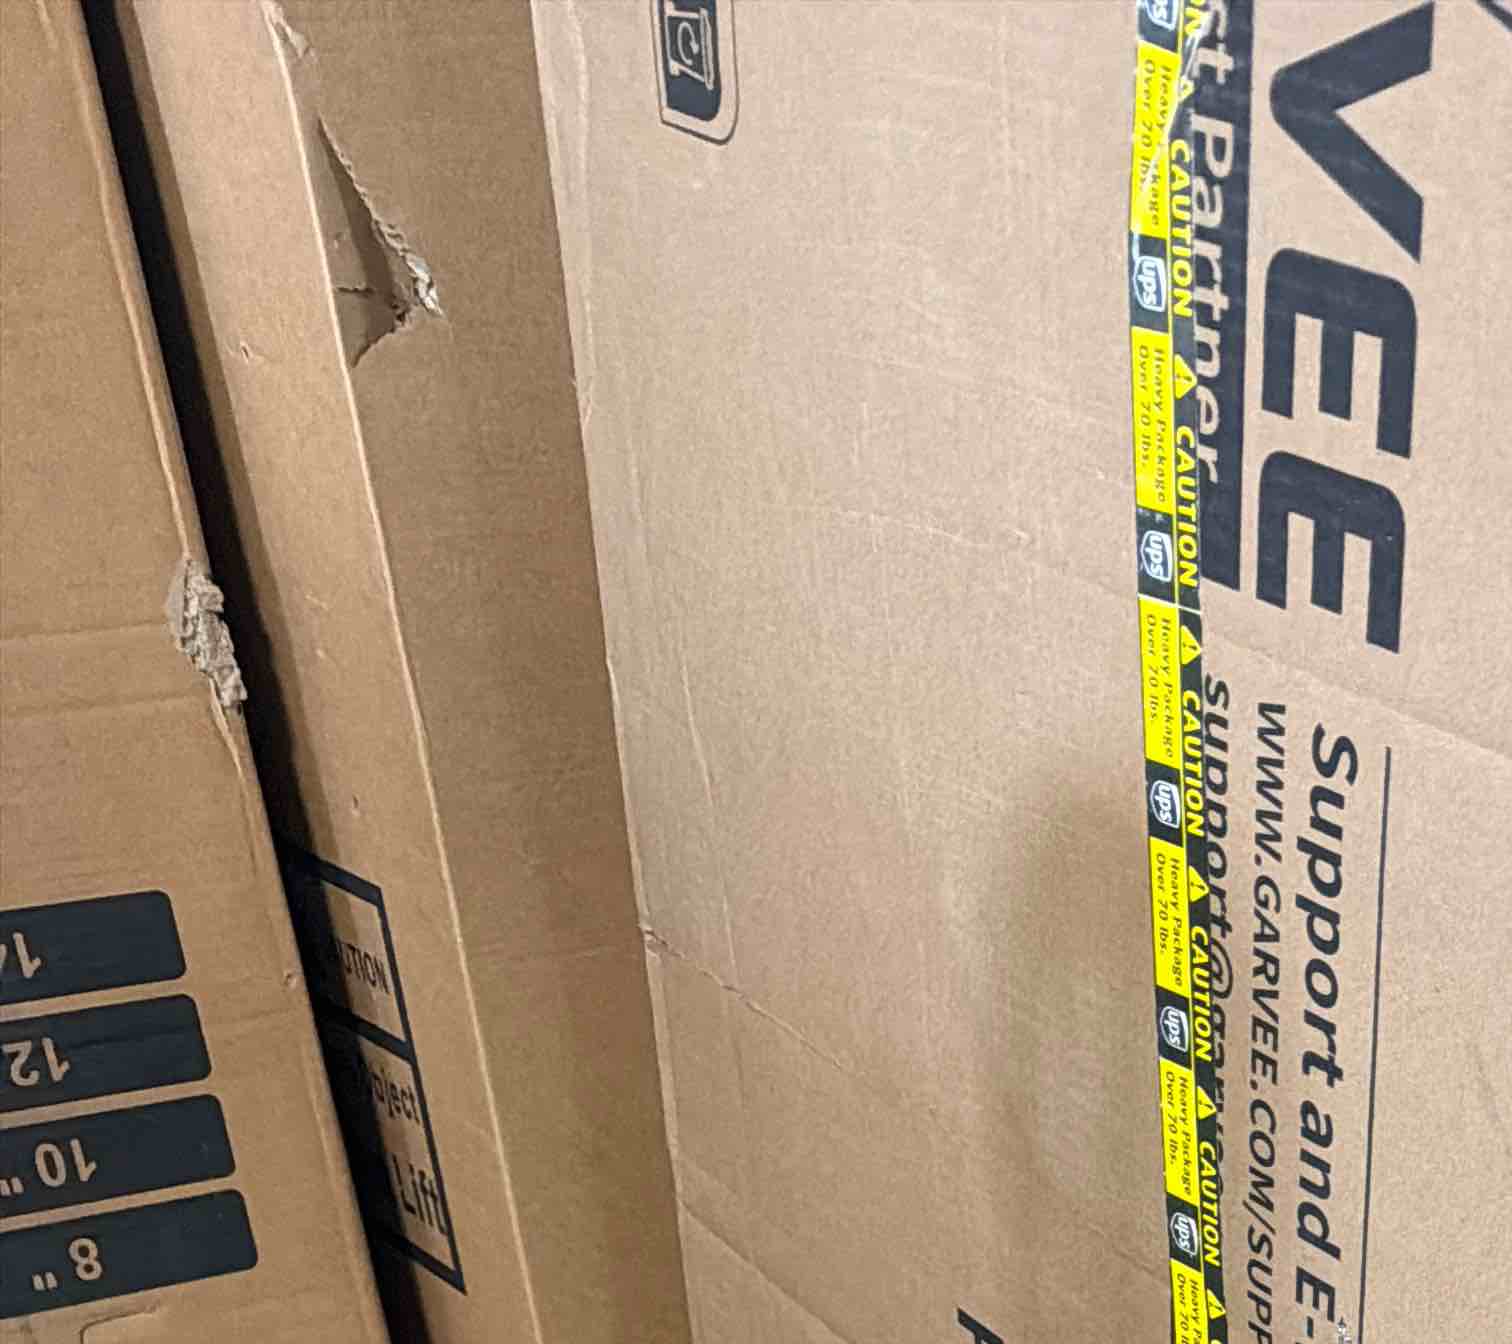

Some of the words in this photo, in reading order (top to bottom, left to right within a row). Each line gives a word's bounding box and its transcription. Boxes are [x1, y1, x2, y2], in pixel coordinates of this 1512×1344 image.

[1168, 138, 1194, 318] CAUTION
[1190, 112, 1235, 483] Partner
[1175, 424, 1199, 588] CAUTION
[1182, 689, 1206, 838] CAUTION
[1295, 722, 1359, 1089] Support
[1190, 925, 1212, 1063] CAUTION
[1198, 1140, 1221, 1268] CAUTION
[1296, 1099, 1342, 1261] and
